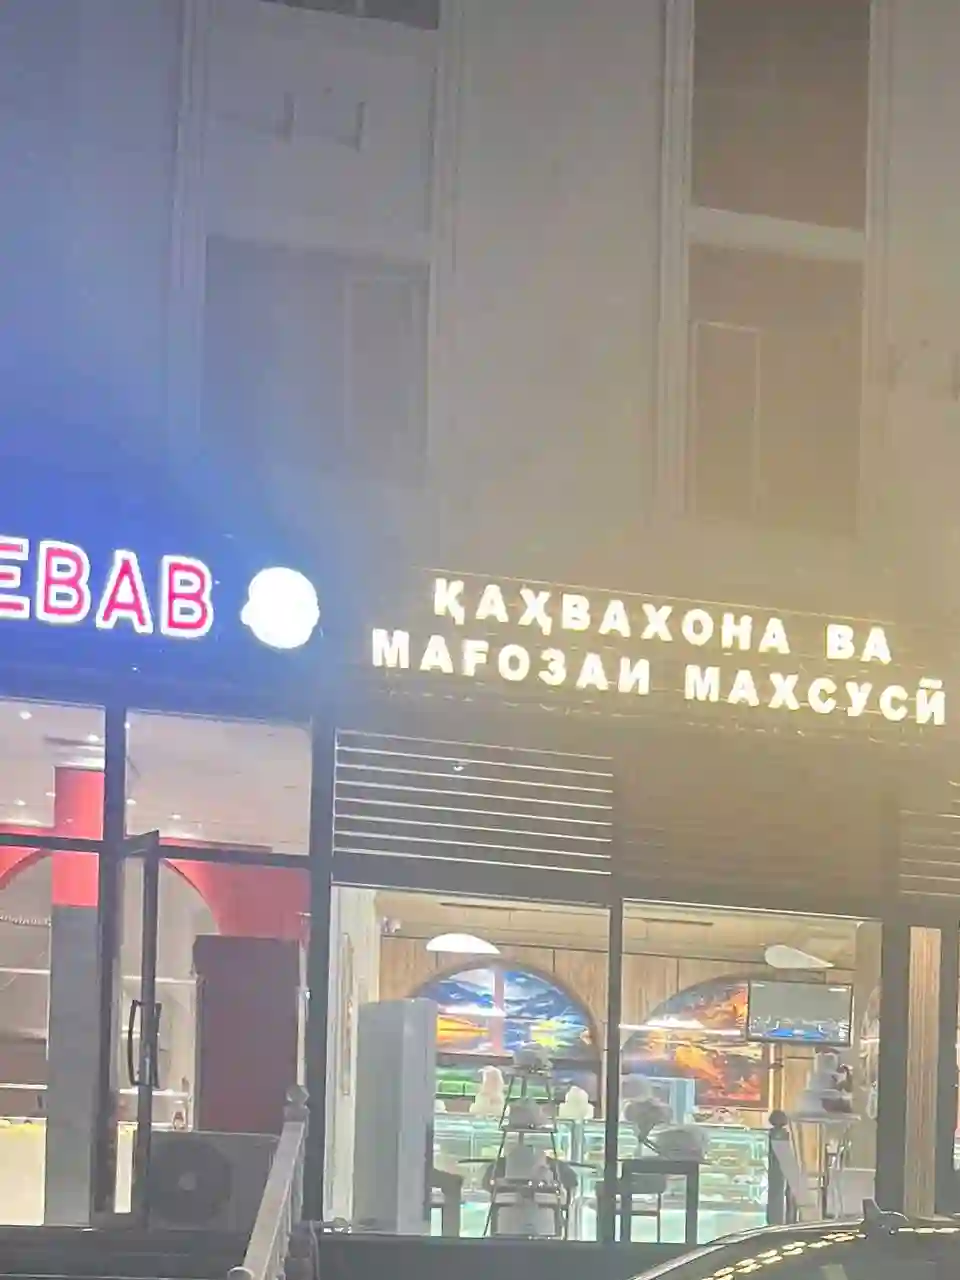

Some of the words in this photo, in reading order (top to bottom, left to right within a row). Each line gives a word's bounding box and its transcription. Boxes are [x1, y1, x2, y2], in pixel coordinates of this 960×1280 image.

[433, 577, 791, 655] ҚАҲВАХОНА
[826, 623, 893, 664] ВА
[684, 663, 947, 726] МАХСУСӢ
